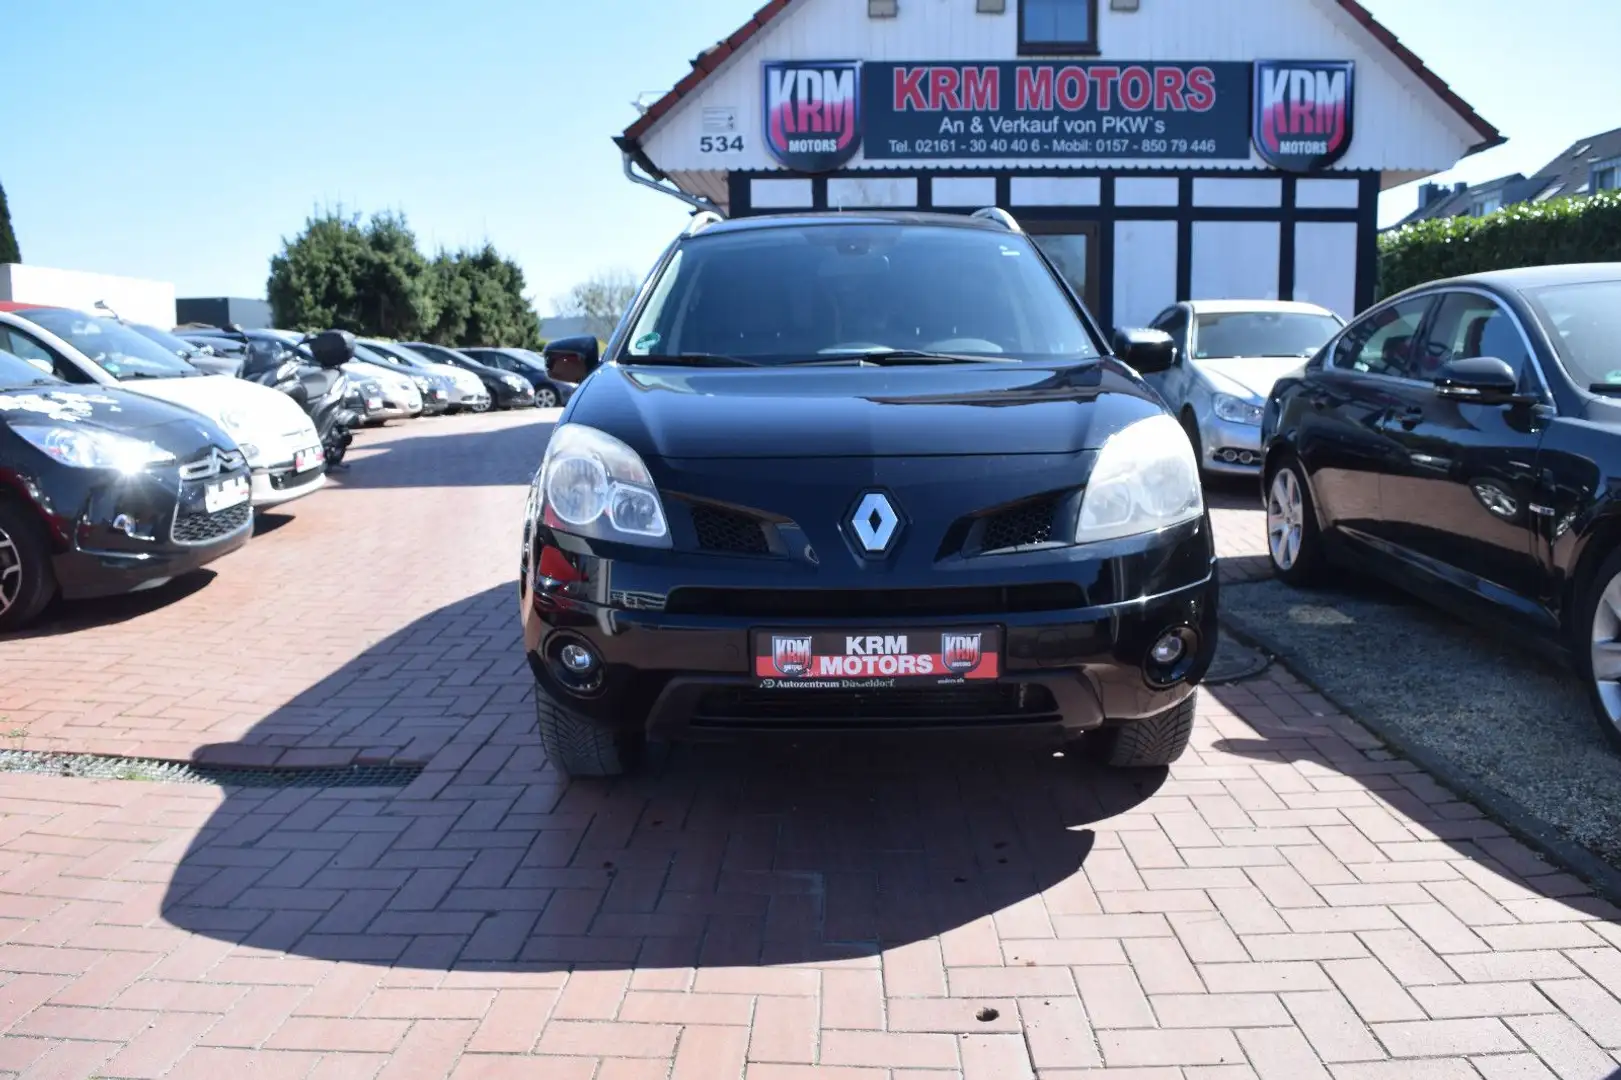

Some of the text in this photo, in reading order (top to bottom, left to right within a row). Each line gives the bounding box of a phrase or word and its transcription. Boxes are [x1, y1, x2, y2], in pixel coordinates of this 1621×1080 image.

[893, 66, 1217, 112] KRM MOTORS
[769, 69, 856, 140] KRM
[1263, 69, 1346, 141] KRM
[939, 116, 965, 134] An
[970, 116, 984, 133] &
[989, 116, 1060, 134] Verkauf
[1064, 119, 1097, 134] von
[700, 135, 745, 153] 534
[788, 139, 837, 153] MOTORS
[889, 139, 912, 152] Tel.
[915, 139, 957, 153] 02161
[970, 139, 987, 152] 30
[990, 139, 1008, 152] 40
[1011, 139, 1029, 152] 40
[1031, 139, 1041, 152] 6
[1052, 139, 1092, 152] Mobil:
[1096, 139, 1129, 152] 0157
[1141, 139, 1167, 152] 850
[1171, 139, 1188, 152] 79
[1190, 139, 1217, 152] 446
[1279, 141, 1327, 155] MOTORS
[775, 639, 810, 664] KRM
[846, 635, 908, 656] KRM
[945, 636, 979, 660] KRM
[820, 654, 934, 676] MOTORS
[776, 679, 840, 689] Autozentrum
